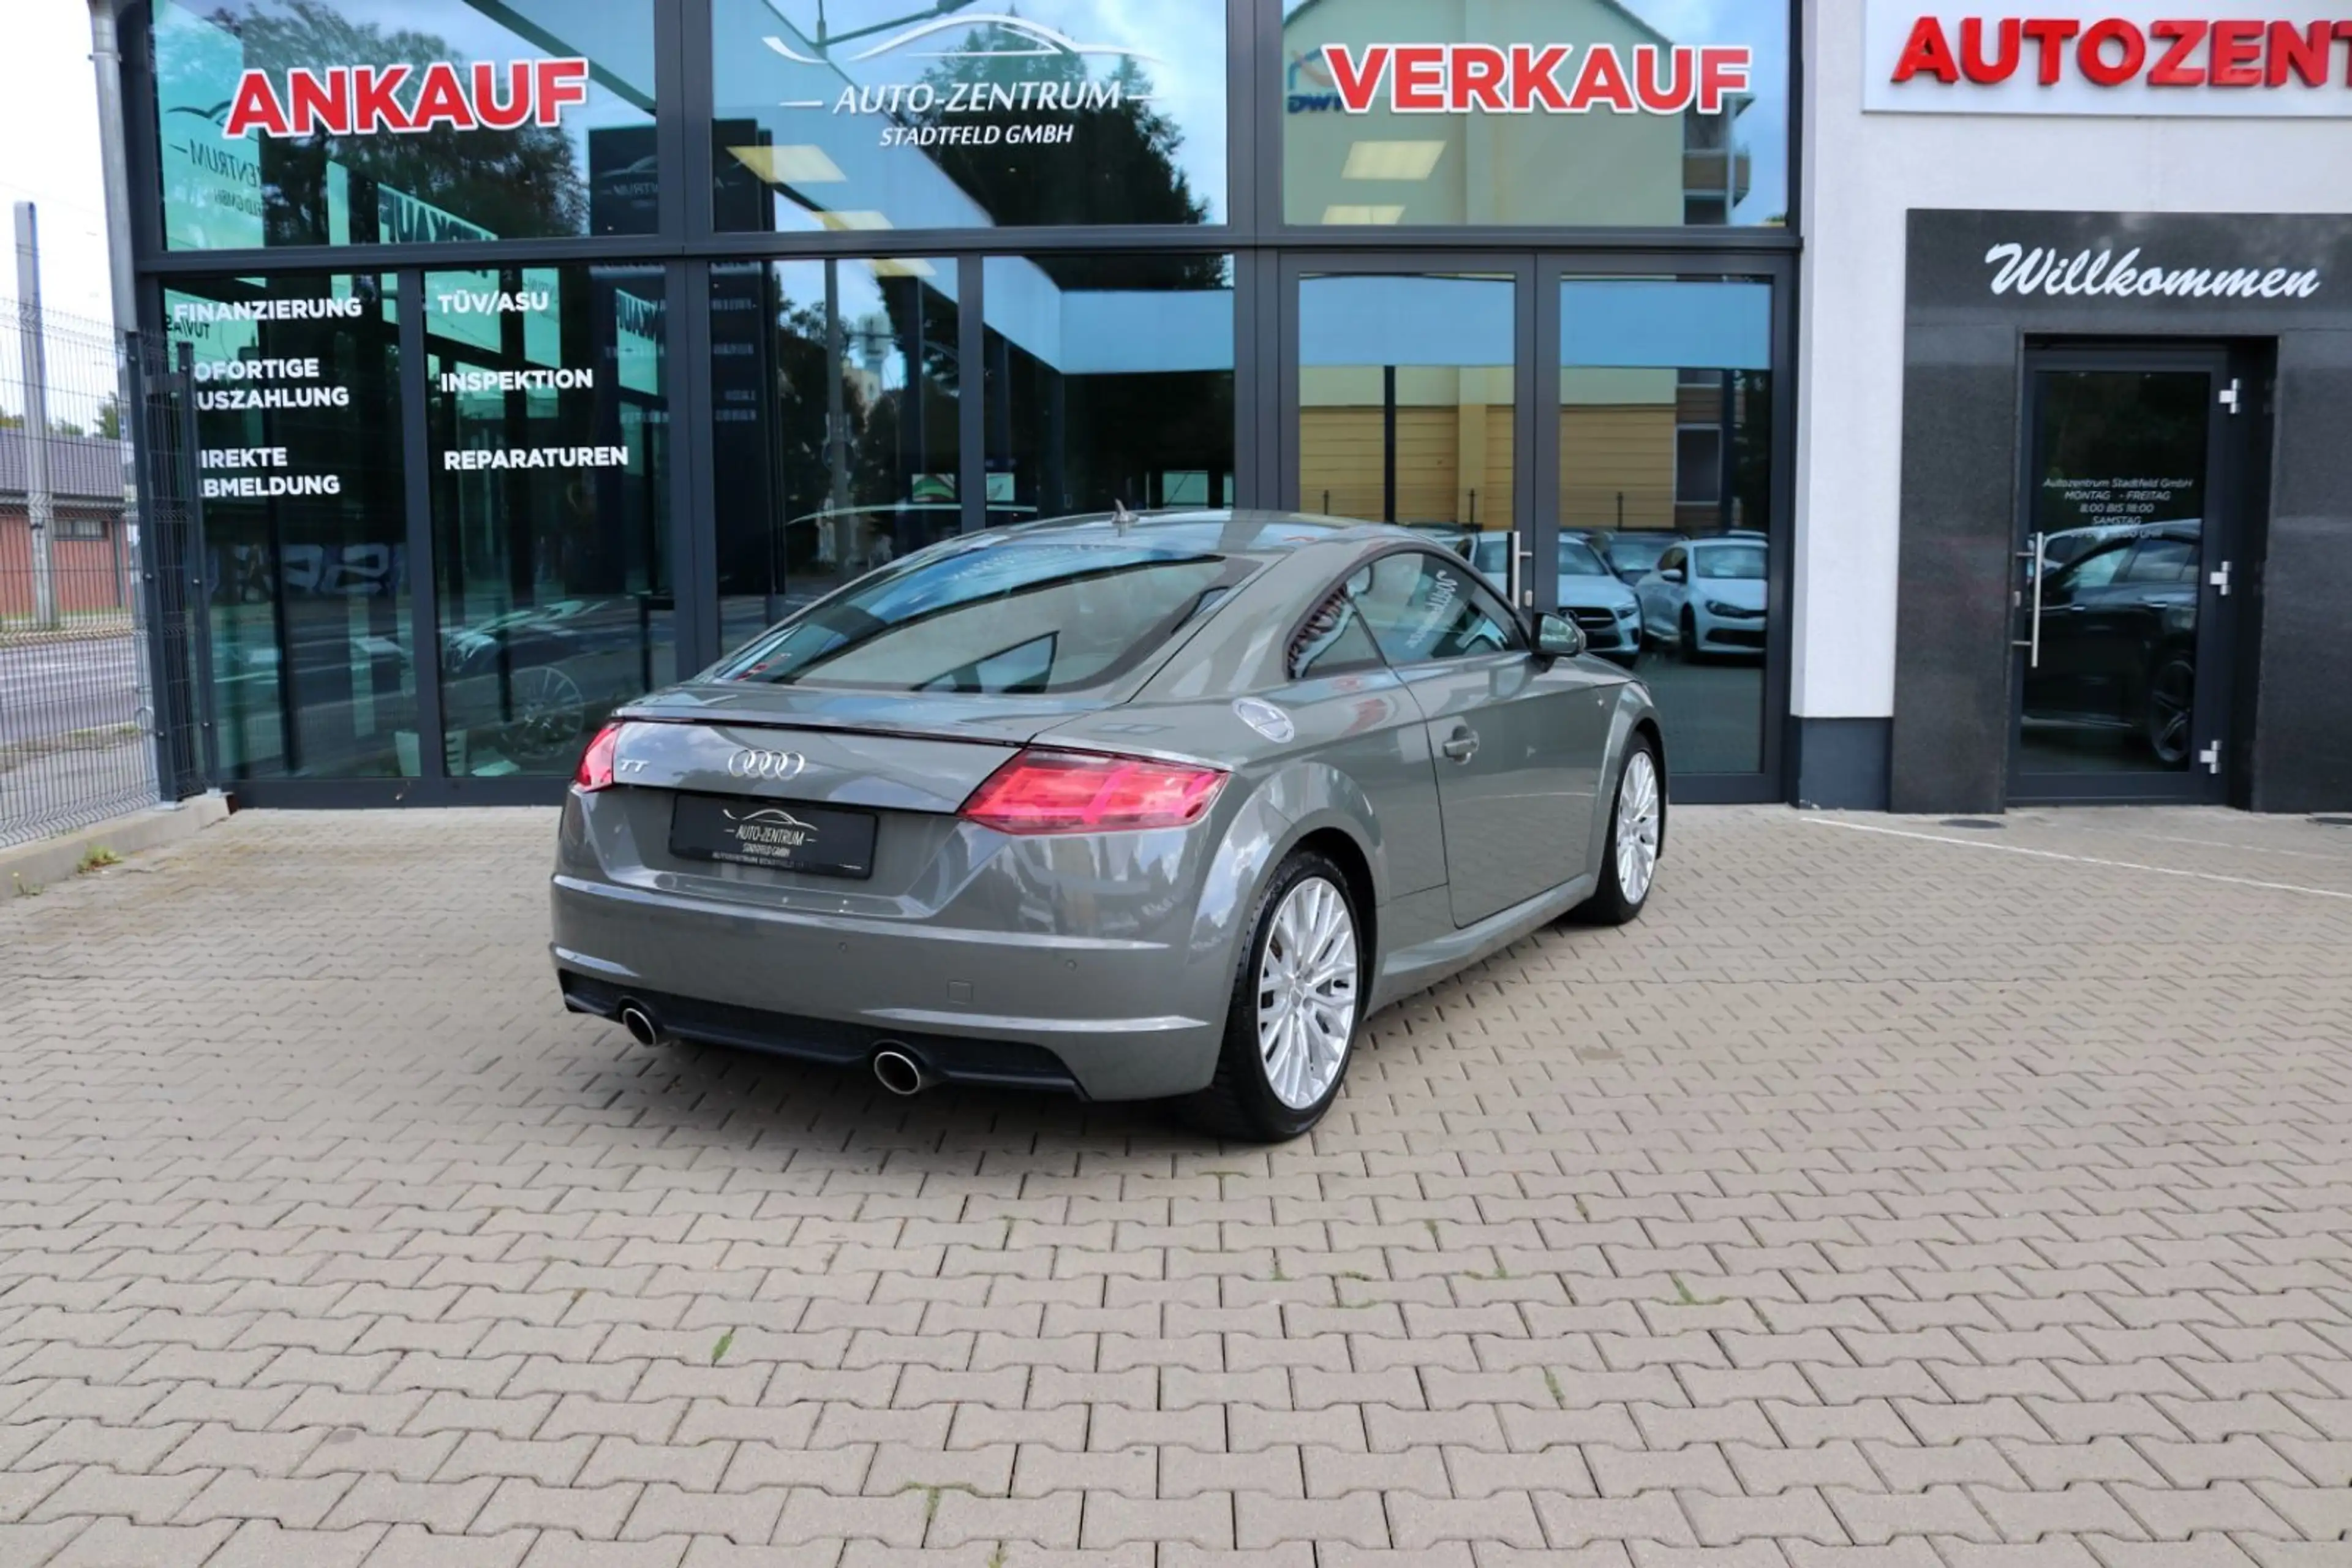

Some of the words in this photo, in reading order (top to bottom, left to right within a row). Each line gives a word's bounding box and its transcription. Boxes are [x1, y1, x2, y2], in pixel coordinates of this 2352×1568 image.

[1321, 43, 1752, 115] VERKAUF
[222, 57, 589, 139] ANKAUF
[832, 80, 1121, 116] AUTO-ZENTRUM
[879, 126, 1001, 147] STADTFELD
[1005, 124, 1075, 145] GMBH
[1985, 243, 2321, 299] Willkommen
[173, 298, 363, 322] FINANZIERUNG
[438, 289, 549, 315] TÜV/ASU
[193, 358, 319, 382] OFORTIGE
[440, 369, 594, 392] INSPEKTION
[195, 386, 349, 410] USZAHLUNG
[196, 447, 288, 469] IREKTE
[443, 446, 629, 470] REPARATUREN
[200, 474, 341, 498] BMELDUNG
[2065, 491, 2111, 500] MONTAG
[2092, 516, 2141, 525] SAMSTAG
[620, 759, 650, 772] TT
